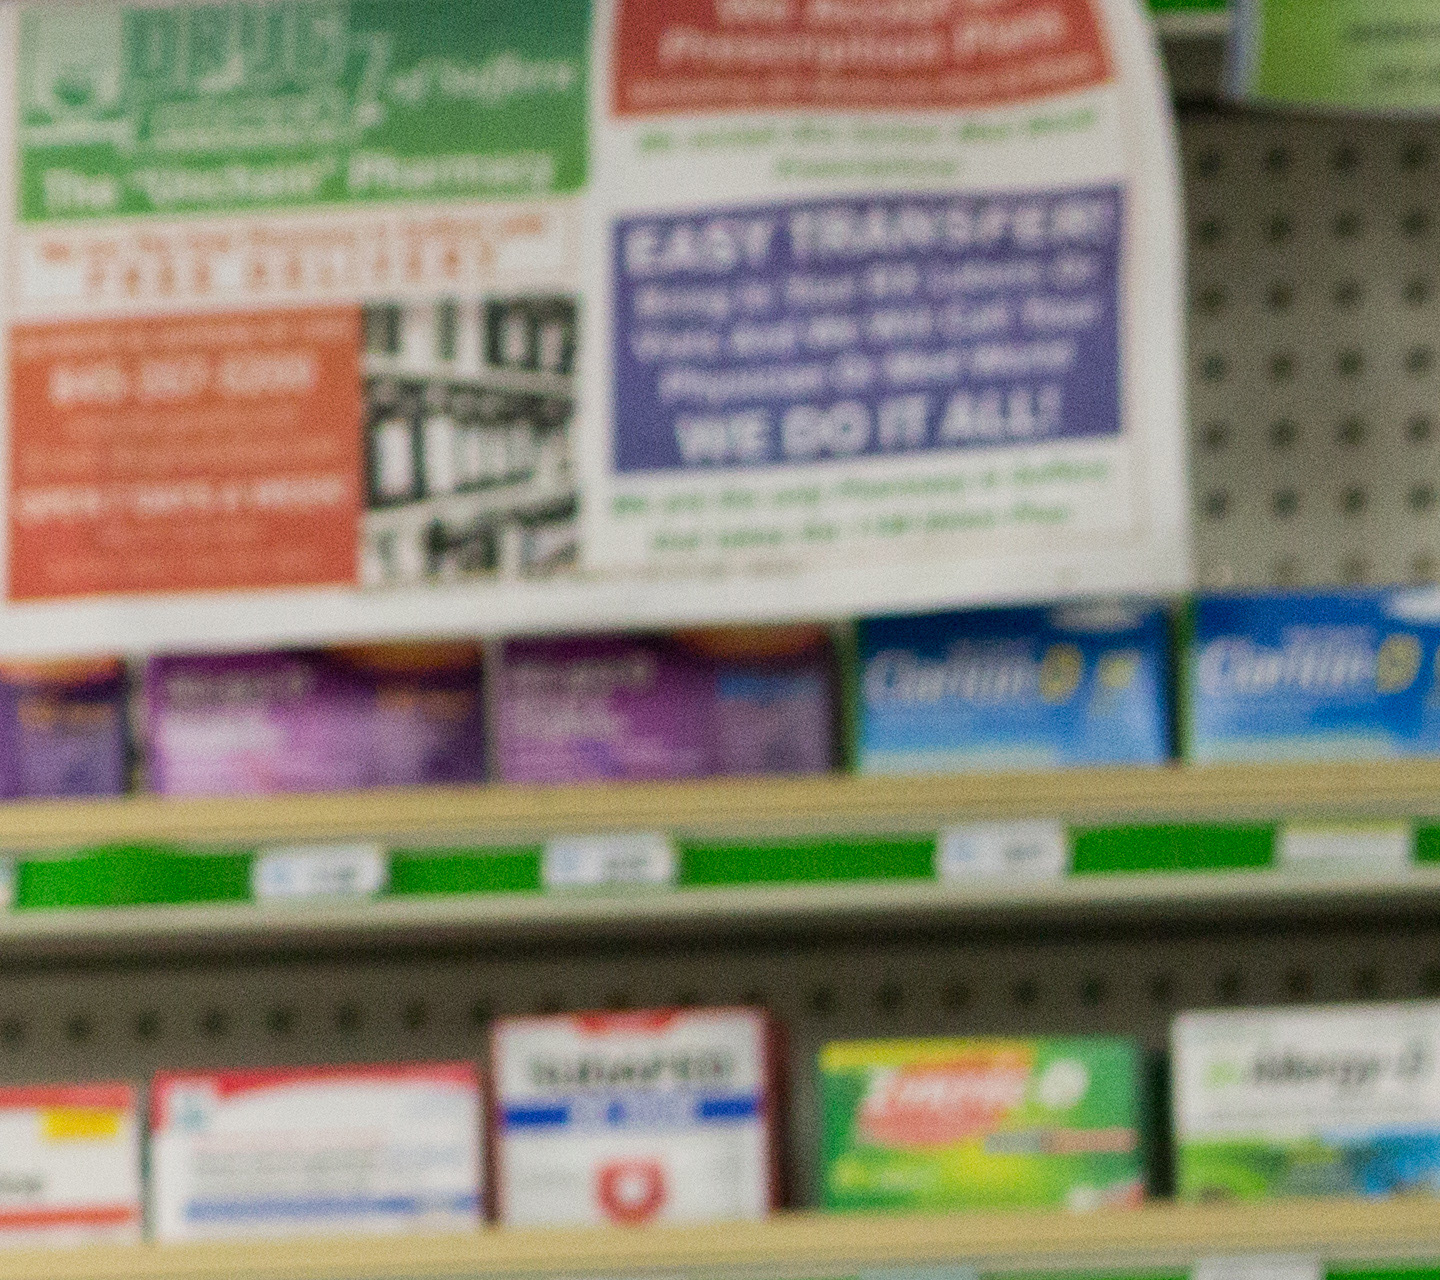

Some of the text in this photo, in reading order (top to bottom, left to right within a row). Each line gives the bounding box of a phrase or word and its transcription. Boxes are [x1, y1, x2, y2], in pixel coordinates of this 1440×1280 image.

[347, 150, 557, 194] Pharmacy
[625, 200, 1118, 276] EASY TRANSFER!
[674, 383, 1064, 465] WE DO IT ALL!
